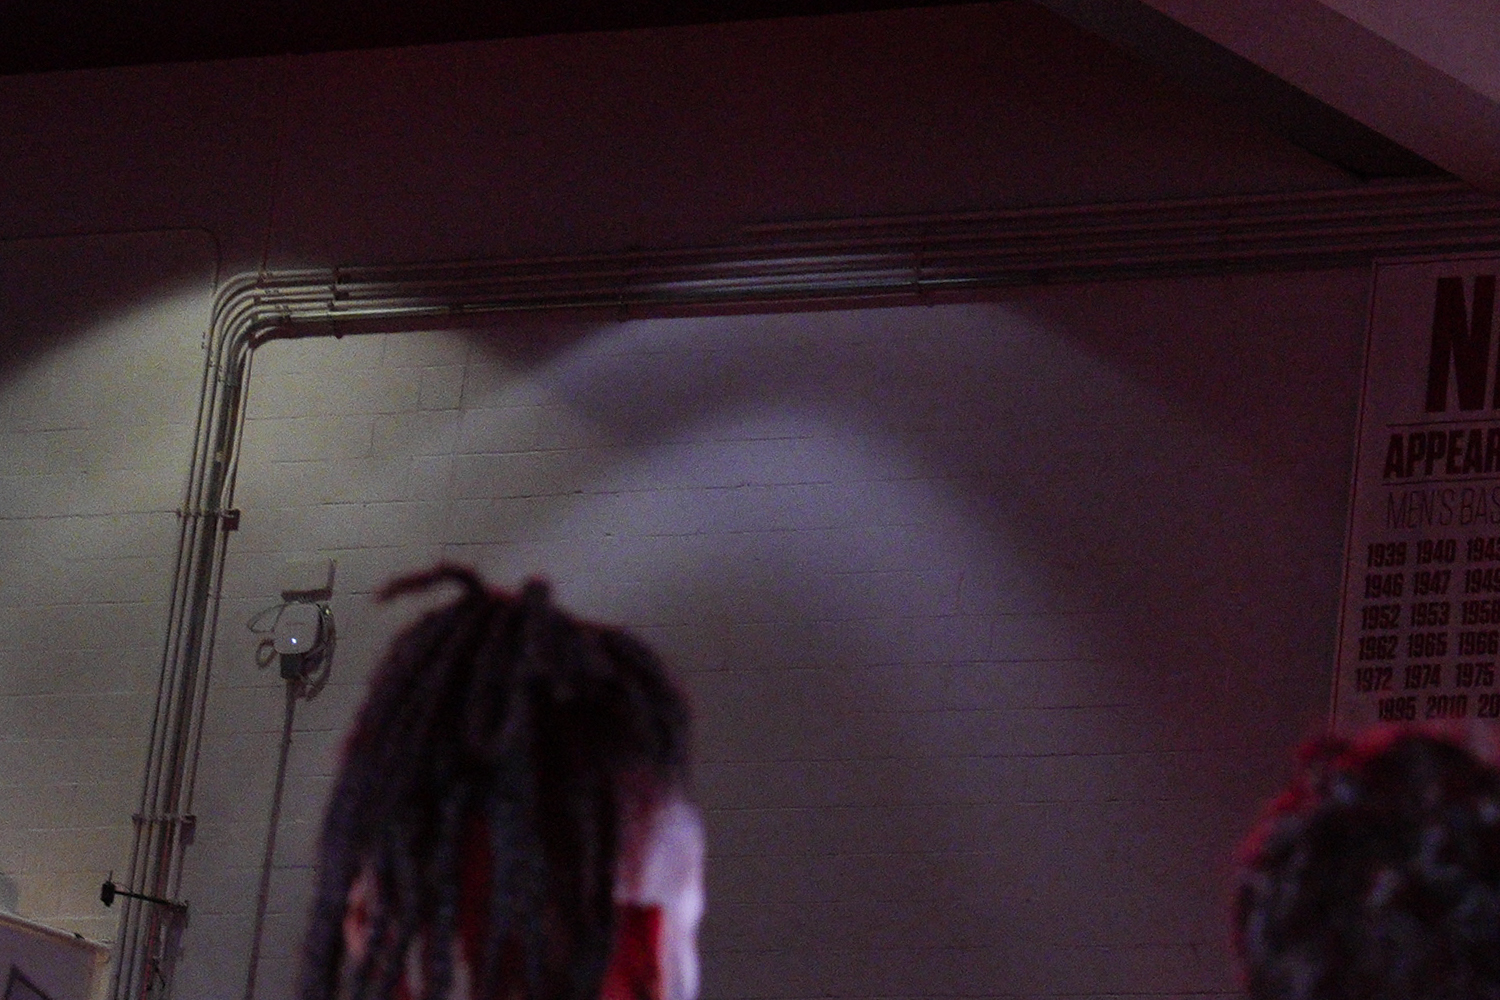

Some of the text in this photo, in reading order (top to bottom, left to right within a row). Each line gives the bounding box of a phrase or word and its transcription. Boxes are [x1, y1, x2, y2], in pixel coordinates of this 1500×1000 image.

[1386, 489, 1455, 530] MEN'S
[1416, 540, 1456, 563] 1940
[1365, 574, 1403, 598] 1946
[1414, 570, 1451, 595] 1947
[1404, 664, 1441, 689] 1974
[1455, 662, 1495, 687] 1975
